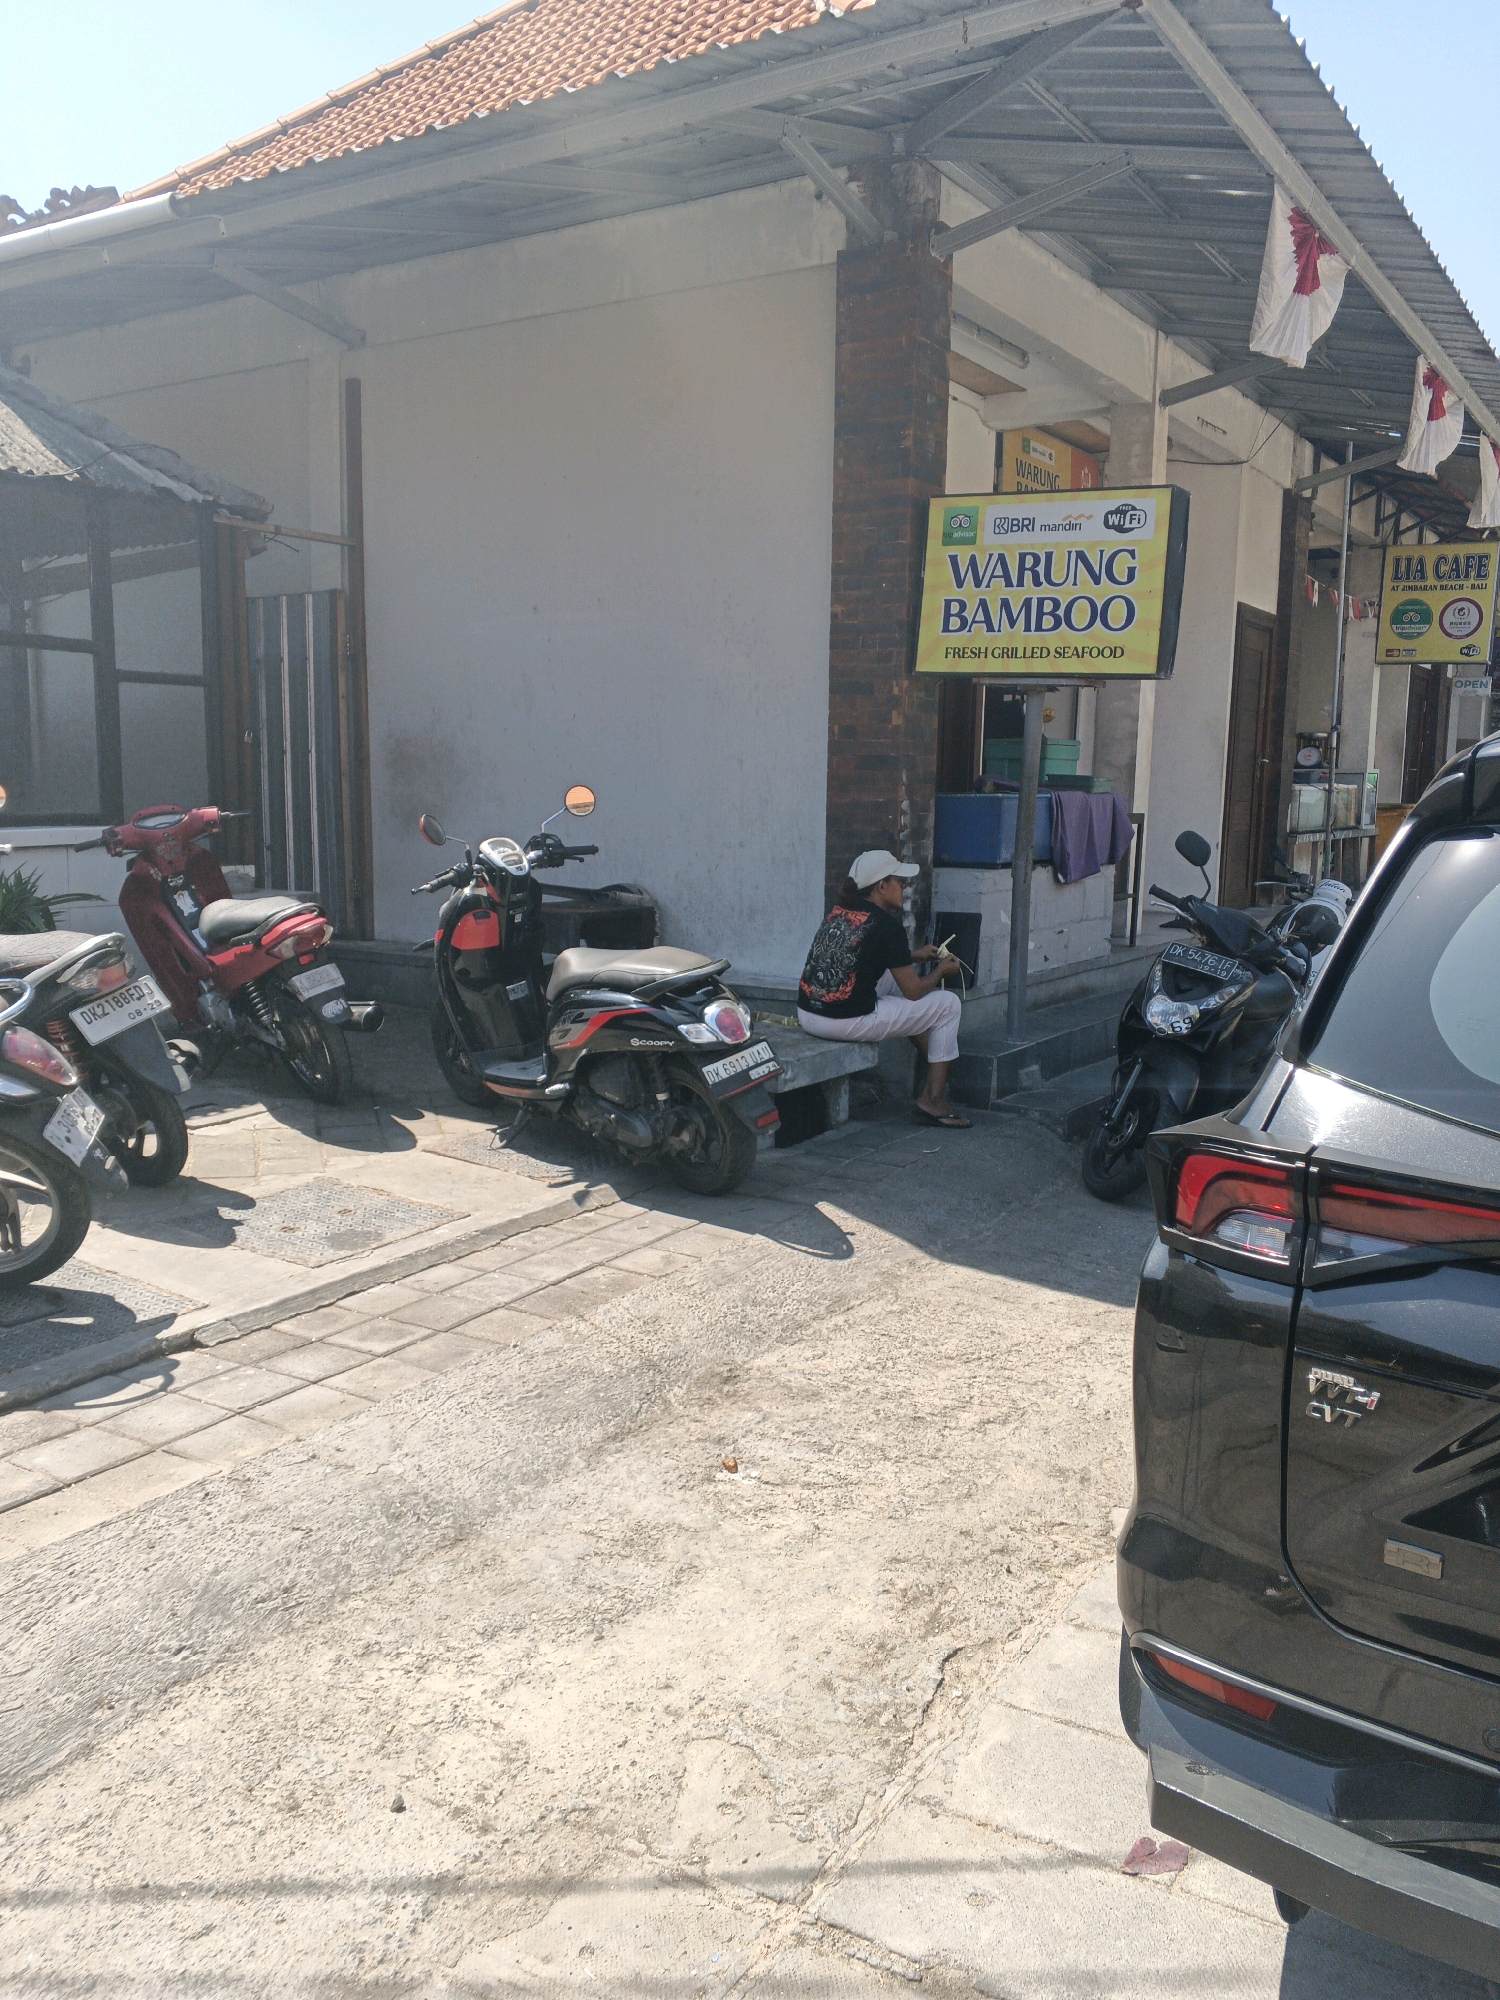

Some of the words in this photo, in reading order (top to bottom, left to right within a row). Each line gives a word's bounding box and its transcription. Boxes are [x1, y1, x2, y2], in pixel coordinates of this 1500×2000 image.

[1015, 457, 1060, 490] WARUNG
[1009, 517, 1035, 533] BRI
[1040, 520, 1082, 532] mandiri
[1108, 513, 1142, 526] WiFi
[948, 548, 1138, 589] WARUNG
[1392, 555, 1428, 582] LIA
[1433, 553, 1490, 582] CAFE
[1401, 584, 1438, 592] JIMBARAN
[1439, 583, 1464, 591] BEACH
[941, 594, 1136, 634] BAMBOO
[945, 646, 988, 660] FRESH
[991, 646, 1050, 660] GRILLED
[1053, 645, 1125, 659] SEAFOOD
[1454, 680, 1488, 689] OPEN
[1169, 944, 1187, 957] DK
[1187, 948, 1218, 966] 5476
[1218, 959, 1233, 970] IF
[706, 1066, 723, 1083] DK
[722, 1056, 750, 1076] 6913
[749, 1046, 771, 1064] UAU
[1311, 1367, 1355, 1387] DUAL
[1305, 1401, 1363, 1428] CVT
